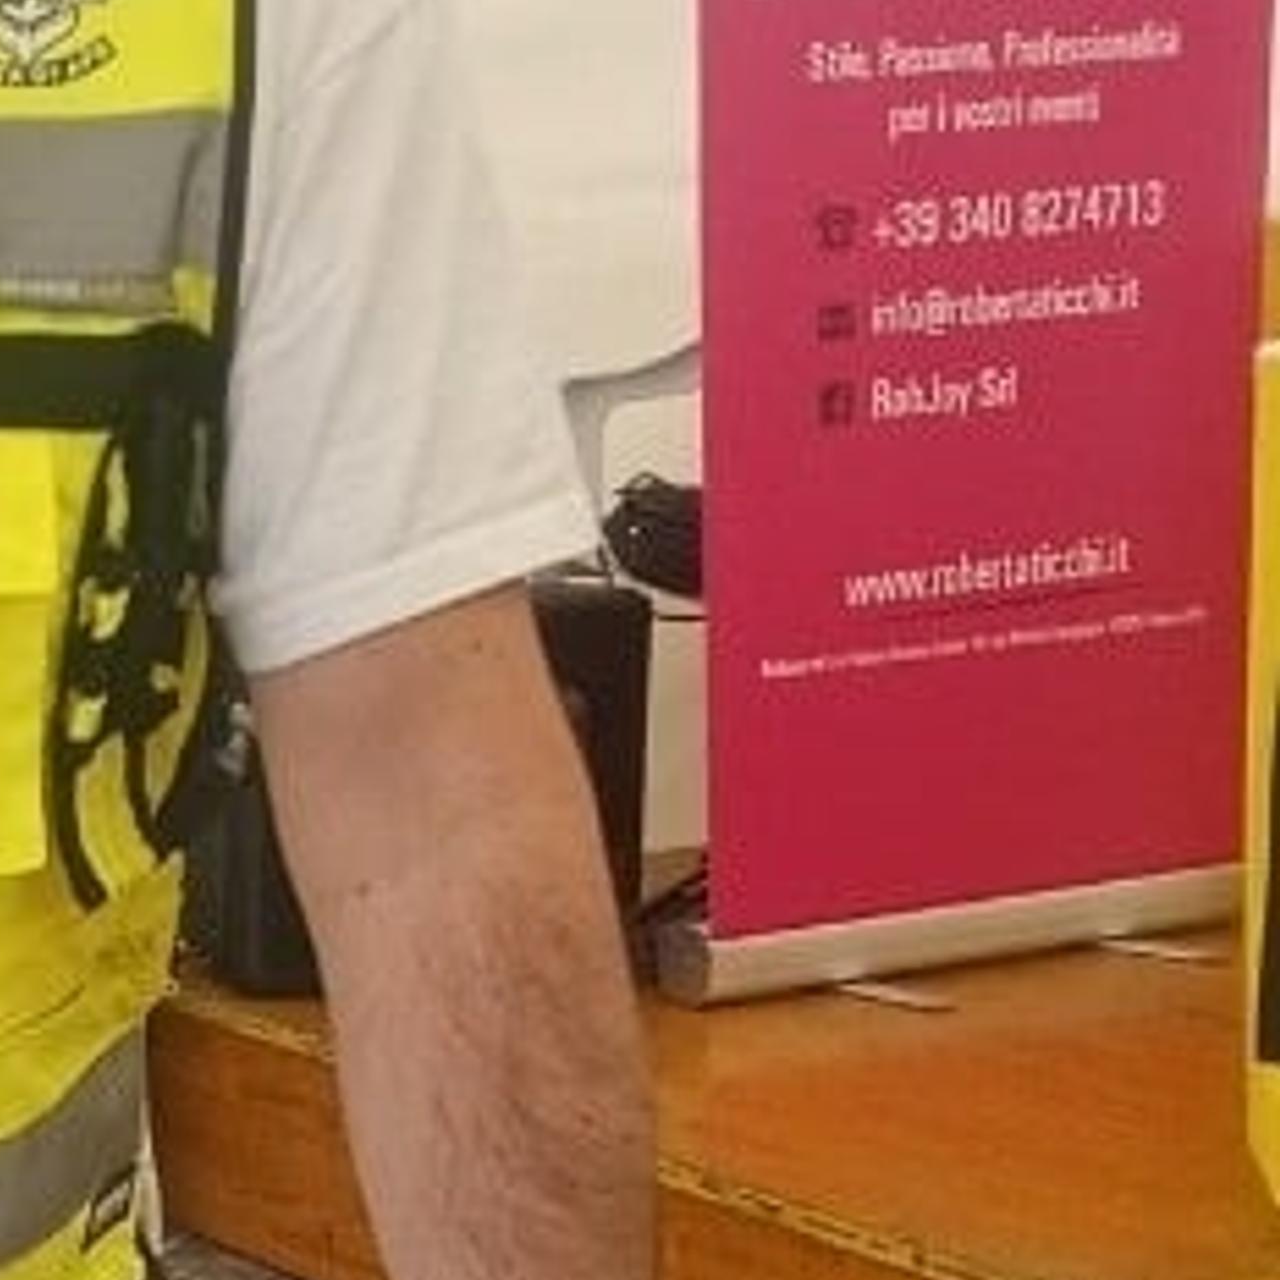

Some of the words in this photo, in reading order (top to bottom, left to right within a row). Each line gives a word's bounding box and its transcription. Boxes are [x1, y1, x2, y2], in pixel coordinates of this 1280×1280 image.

[870, 199, 938, 248] +39
[949, 195, 1013, 244] 340
[1021, 180, 1167, 239] 8274713
